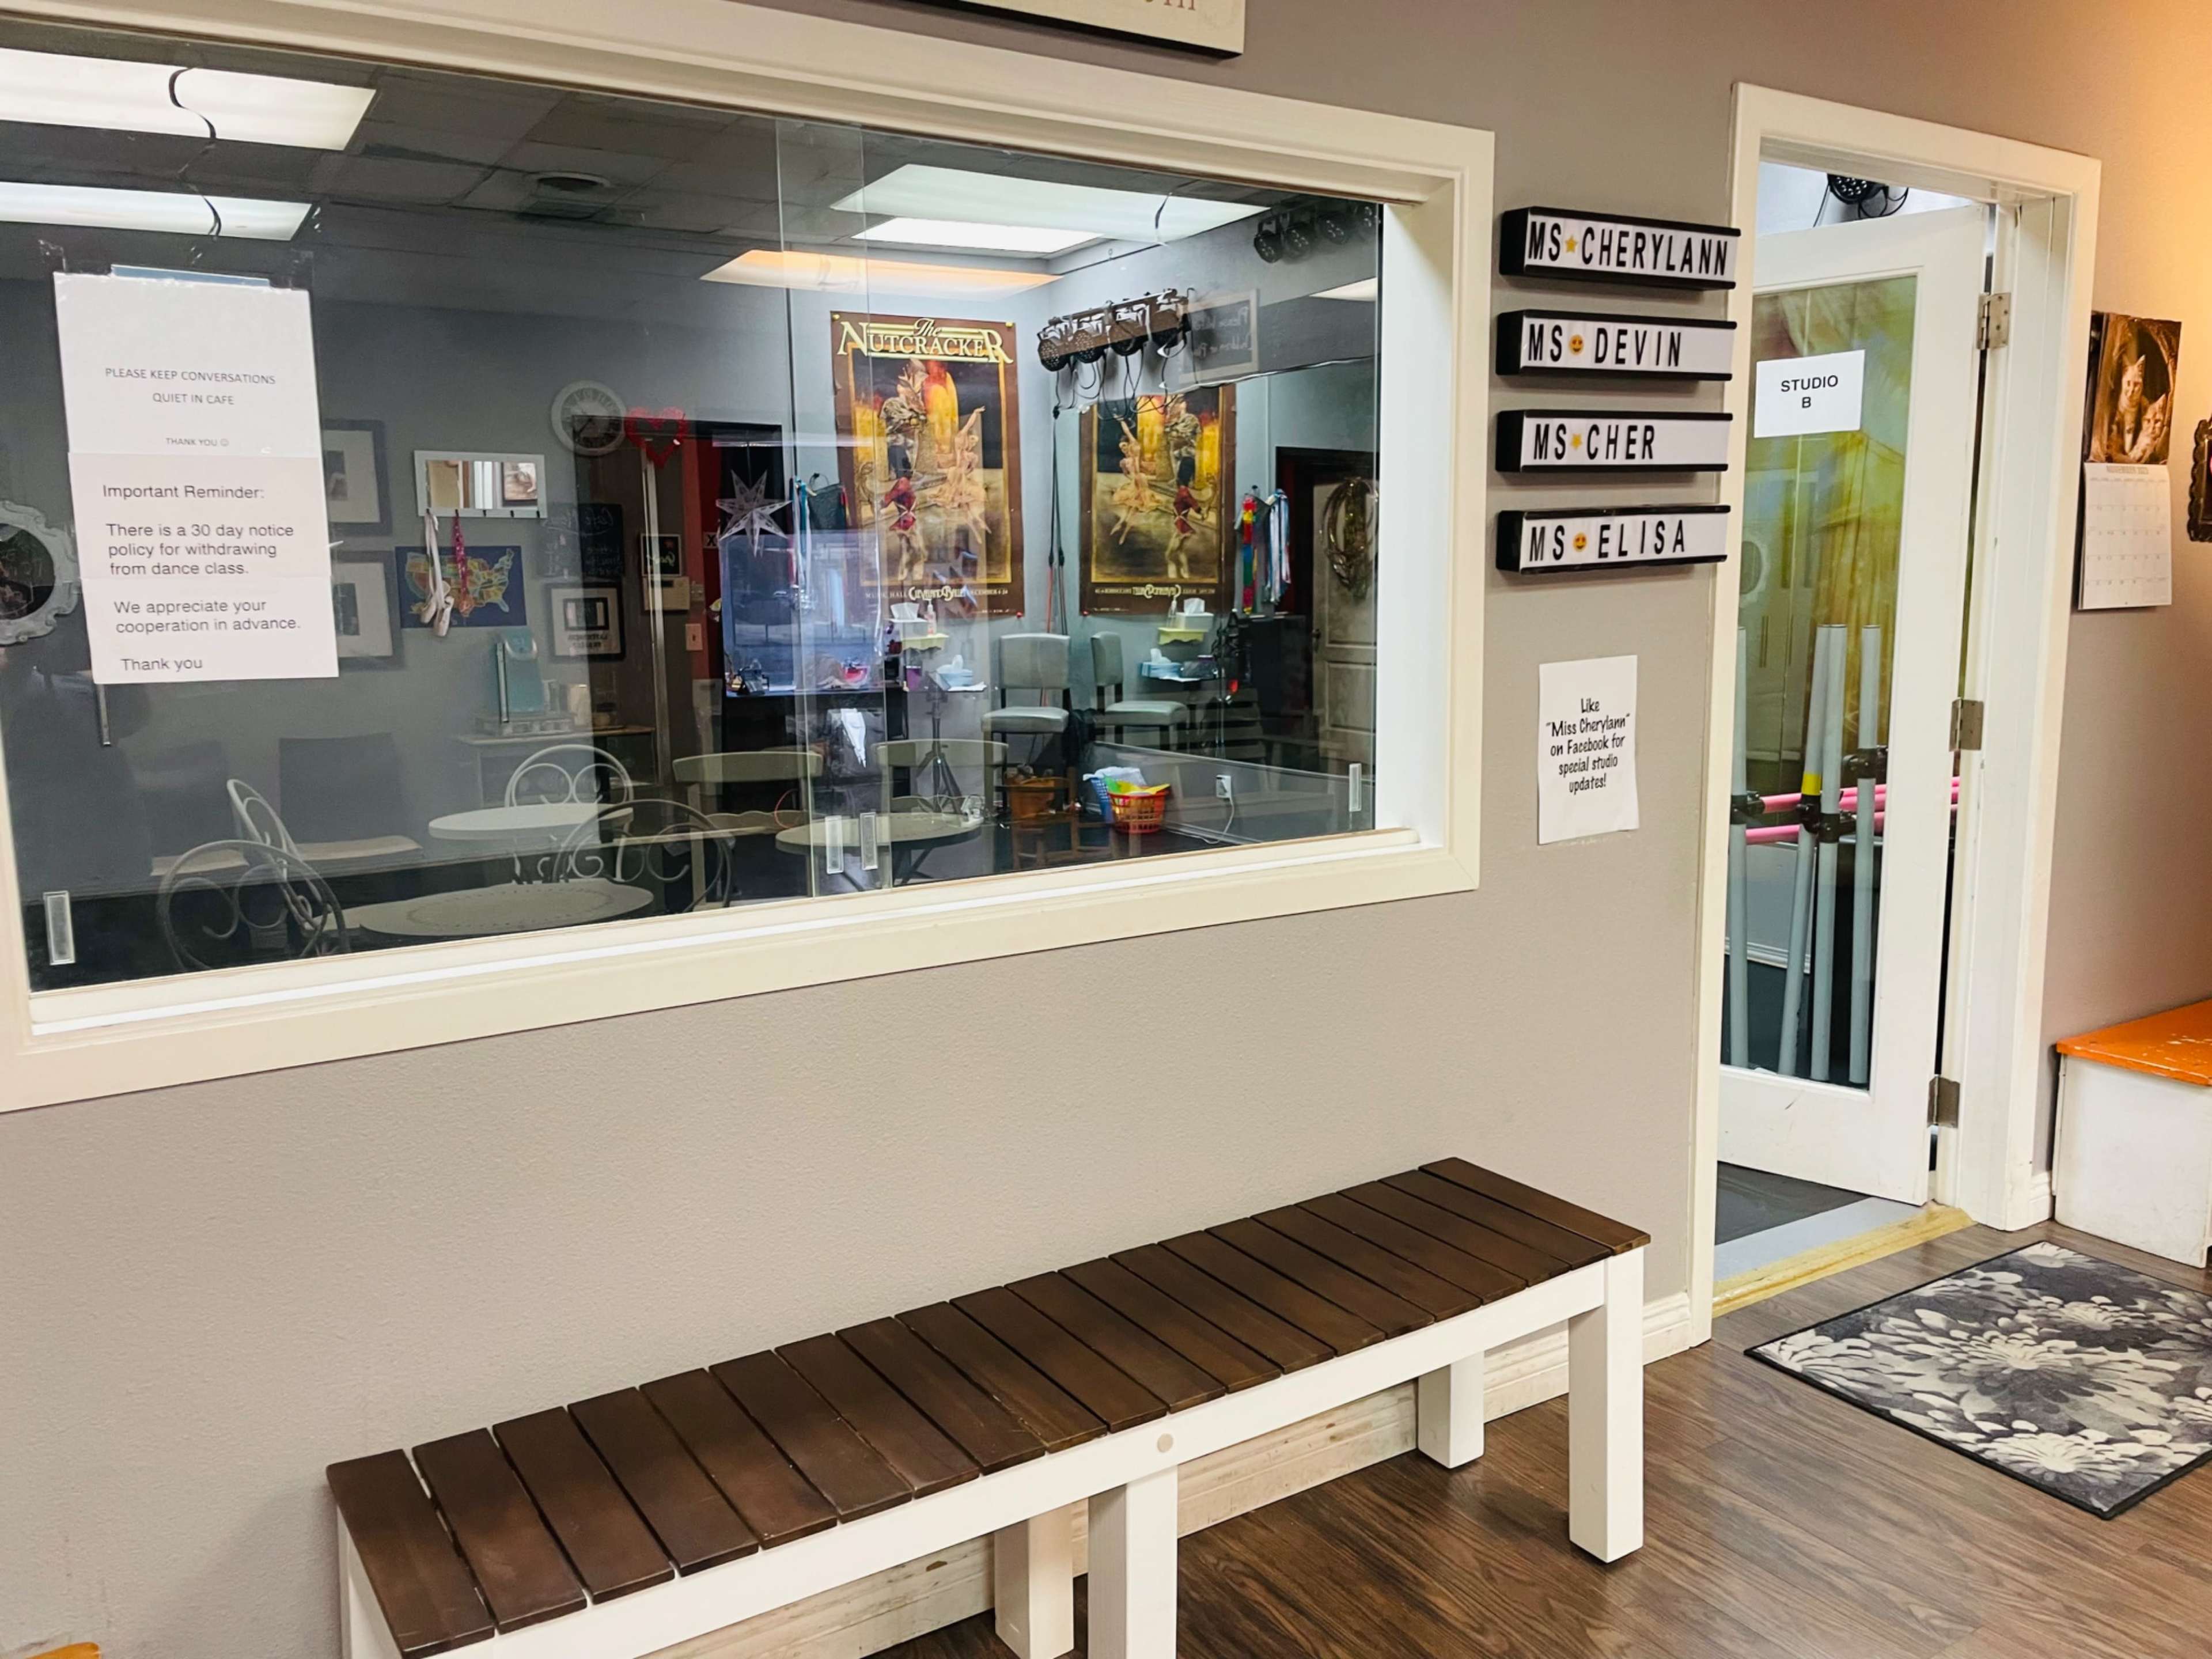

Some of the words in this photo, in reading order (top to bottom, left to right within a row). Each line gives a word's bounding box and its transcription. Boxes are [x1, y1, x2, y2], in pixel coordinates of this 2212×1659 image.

[1528, 221, 1562, 262] MS
[1582, 226, 1728, 276] CHERYLANN
[914, 318, 941, 337] The
[837, 321, 1014, 364] NUTCRACKER
[1528, 323, 1563, 362] MS
[1594, 327, 1681, 367] DEVIN
[105, 368, 147, 378] PLEASE
[150, 369, 178, 380] KEEP
[181, 371, 276, 385] CONVERSATIONS
[1781, 375, 1839, 392] STUDIO
[152, 392, 188, 404] QUIET
[191, 393, 203, 404] IN
[206, 395, 235, 405] CAFE
[1801, 397, 1812, 408] B
[165, 437, 196, 446] THANK
[198, 438, 218, 446] YOU
[1533, 423, 1567, 460] MS
[1586, 424, 1656, 460] CHER
[103, 484, 179, 500] Important
[184, 485, 264, 499] Reminder:
[105, 523, 153, 537] There
[158, 524, 172, 536] is
[177, 527, 187, 536] a
[191, 524, 211, 536] 30
[215, 524, 244, 539] day
[249, 524, 294, 536] notice
[1529, 525, 1565, 562] MS
[1598, 519, 1685, 558] ELISA
[108, 544, 154, 559] policy
[159, 543, 180, 556] for
[185, 543, 277, 558] withdrawing
[110, 562, 146, 575] from
[151, 562, 200, 575] dance
[204, 562, 249, 575] class.
[114, 601, 140, 613] We
[146, 600, 229, 615] appreciate
[232, 601, 267, 614] your
[116, 619, 209, 635] cooperation
[214, 619, 228, 631] in
[232, 618, 301, 631] advance.
[120, 658, 171, 672] Thank
[174, 658, 203, 672] you
[1580, 698, 1600, 713] Like
[1551, 744, 1563, 756] on
[1567, 736, 1609, 754] Facebook
[1612, 733, 1625, 748] for
[1559, 757, 1589, 777] special
[1592, 754, 1618, 770] studio
[1569, 774, 1606, 794] updates!
